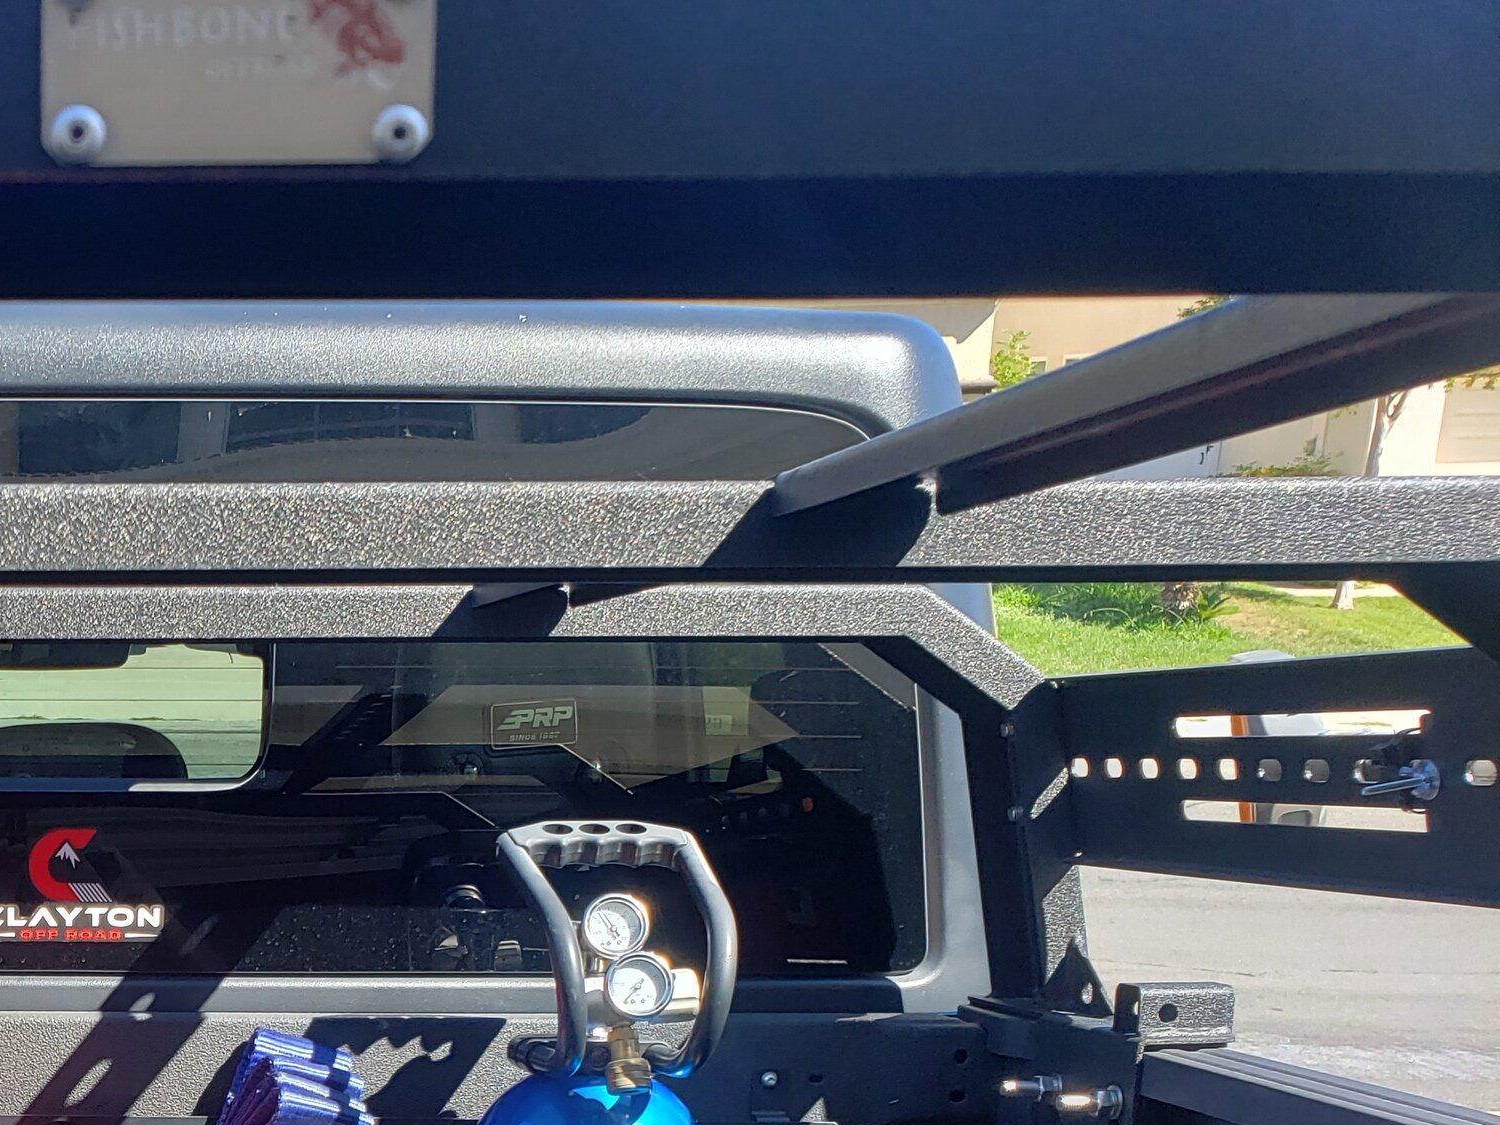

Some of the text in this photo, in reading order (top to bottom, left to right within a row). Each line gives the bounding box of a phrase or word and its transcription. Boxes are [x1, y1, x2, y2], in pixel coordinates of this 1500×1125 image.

[496, 706, 573, 731] PRP
[19, 929, 122, 941] OFF ROAD
